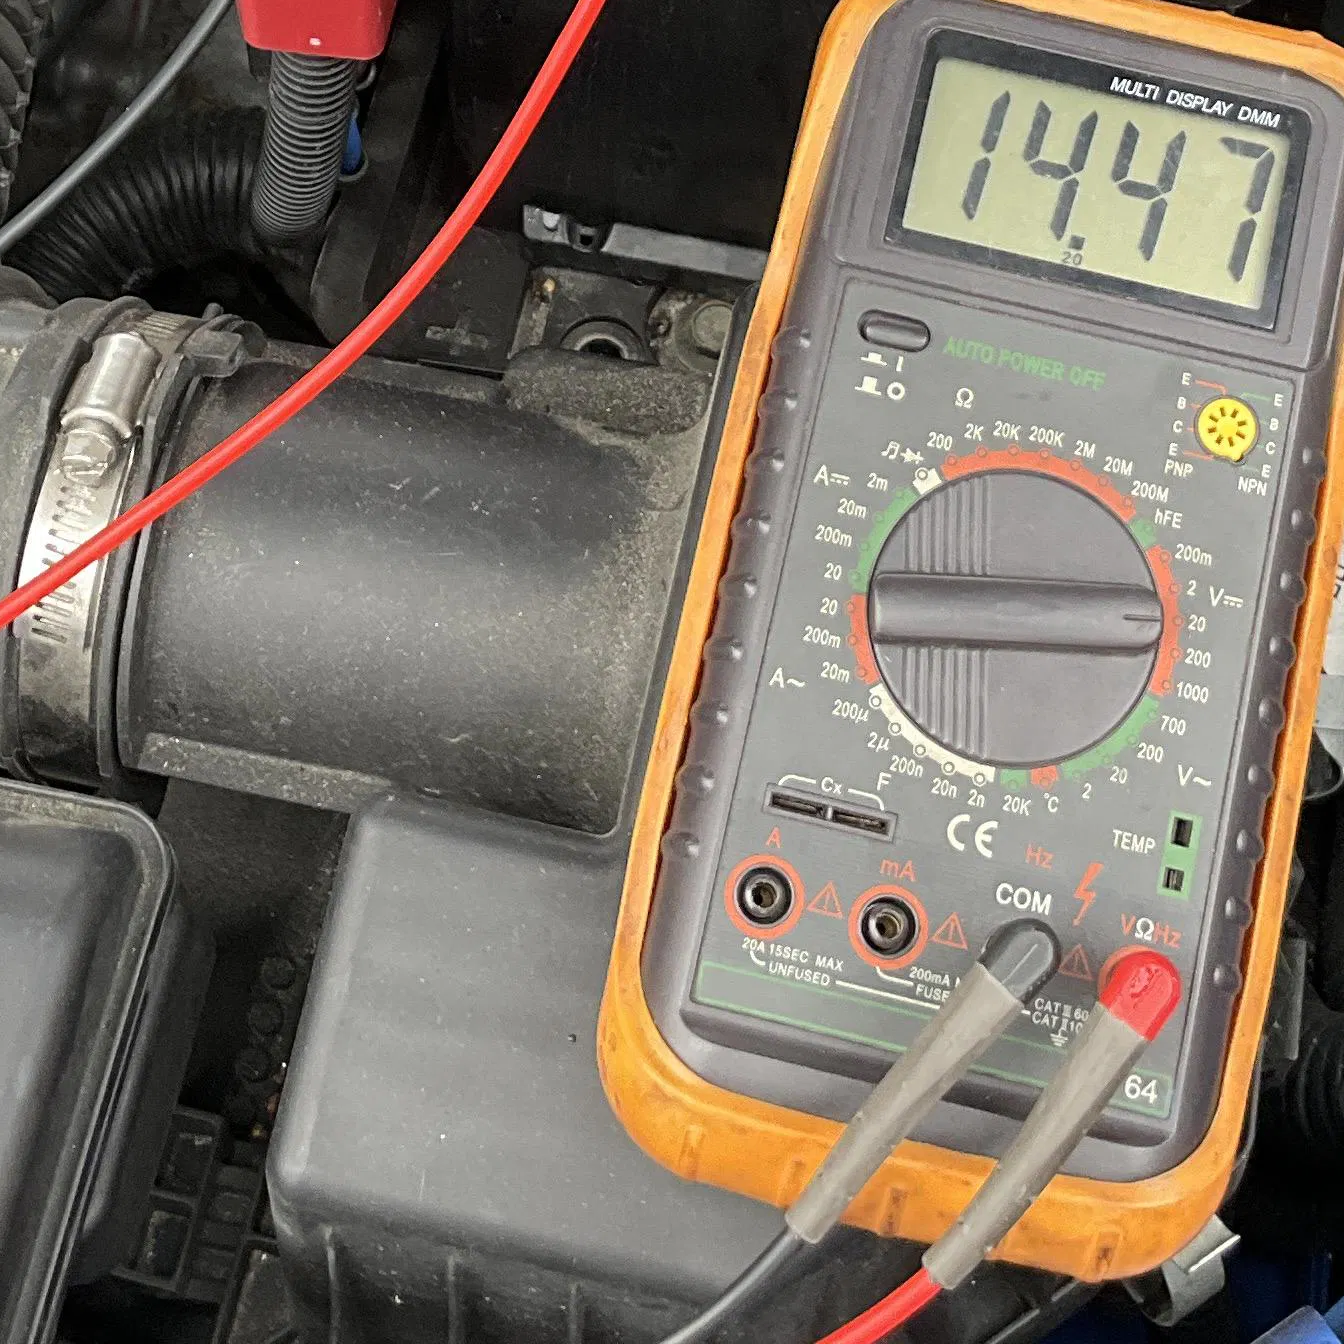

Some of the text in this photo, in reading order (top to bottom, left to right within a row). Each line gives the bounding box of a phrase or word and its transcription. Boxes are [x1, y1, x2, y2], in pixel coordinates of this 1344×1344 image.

[1110, 75, 1281, 130] MULTI DISPLAY DMM
[961, 90, 1275, 283] 14.47
[1061, 250, 1084, 266] 20
[943, 338, 1106, 390] AUTO POWER OFF
[1181, 373, 1191, 387] E
[1177, 396, 1186, 410] B
[1273, 392, 1283, 407] E
[964, 424, 984, 441] 2K
[992, 421, 1020, 440] 20K
[1173, 419, 1183, 433] C
[1269, 417, 1279, 431] B
[927, 432, 953, 451] 200
[1029, 425, 1065, 447] 200K
[1074, 438, 1096, 458] 2M
[1168, 442, 1178, 456] E
[1265, 441, 1276, 455] C
[1103, 456, 1133, 477] 20M
[1164, 460, 1194, 477] PNP
[1261, 464, 1271, 478] E
[867, 473, 888, 492] 2m
[1131, 479, 1169, 504] 200M
[1238, 477, 1267, 497] NPN
[837, 498, 867, 519] 20m
[1154, 508, 1183, 529] hFE
[815, 525, 852, 548] 200m
[1174, 543, 1213, 566] 200m
[824, 563, 842, 581] 20
[1186, 581, 1197, 596] 2
[820, 599, 838, 616] 20
[1189, 616, 1206, 632] 20
[803, 626, 841, 650] 200m
[1184, 649, 1211, 669] 200
[821, 661, 850, 683] 20m
[1176, 683, 1209, 704] 1000
[1160, 716, 1186, 736] 700
[1137, 741, 1164, 762] 200
[891, 756, 925, 780] 200n
[1110, 766, 1128, 785] 20
[876, 774, 891, 792] F
[931, 778, 958, 800] 20n
[1082, 783, 1092, 800] 2
[968, 789, 986, 807] 2n
[1003, 794, 1030, 817] 20K
[765, 827, 782, 848] A
[1112, 828, 1156, 854] TEMP
[1024, 842, 1054, 871] Hz
[879, 859, 917, 883] mA
[995, 882, 1053, 916] COM
[741, 936, 844, 973] 20A 15SEC MAX
[768, 961, 832, 987] UNFUSED
[909, 966, 950, 987] 200mA
[1034, 997, 1061, 1015] CAT
[1032, 1011, 1059, 1028] CAT
